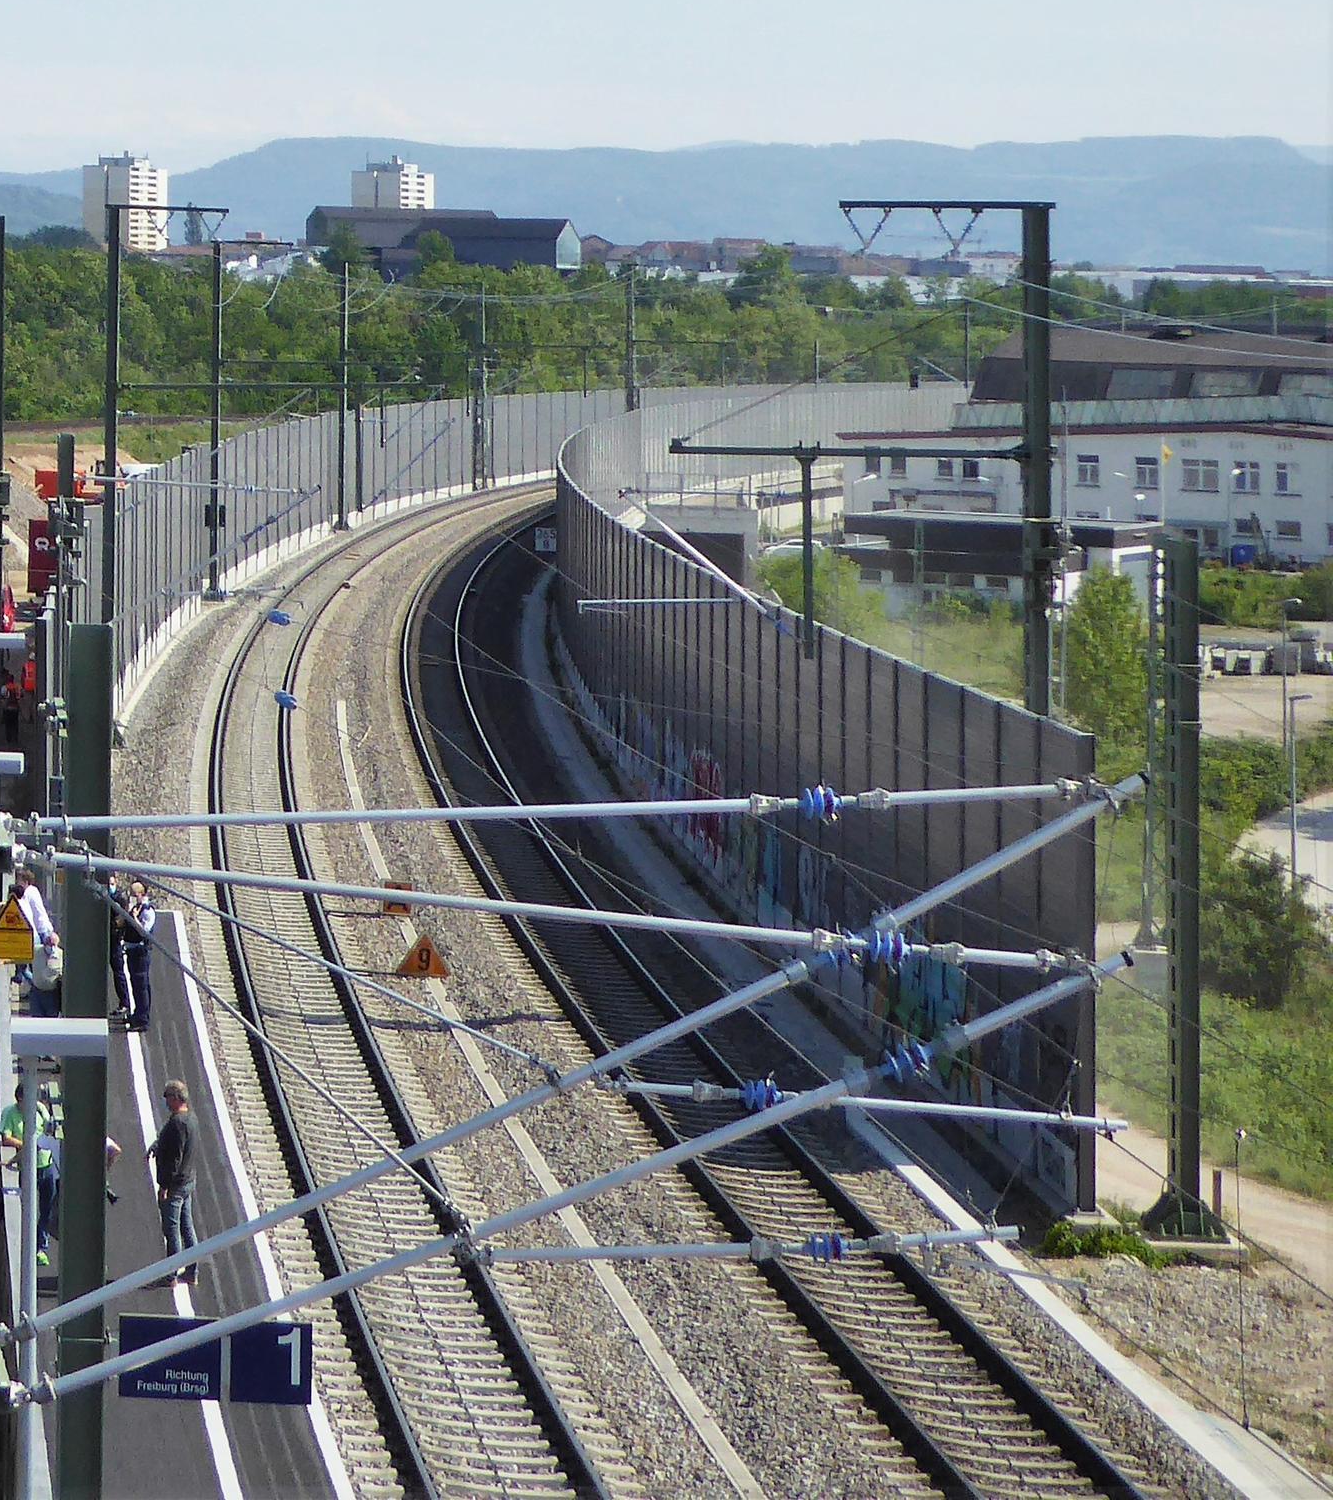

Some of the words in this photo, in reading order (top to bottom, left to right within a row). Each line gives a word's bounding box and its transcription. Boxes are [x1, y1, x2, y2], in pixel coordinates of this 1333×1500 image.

[418, 948, 431, 971] 9
[277, 1327, 302, 1386] 1
[165, 1369, 209, 1382] Richtung
[136, 1380, 178, 1393] Freiburg
[180, 1381, 209, 1395] (Brsg)
